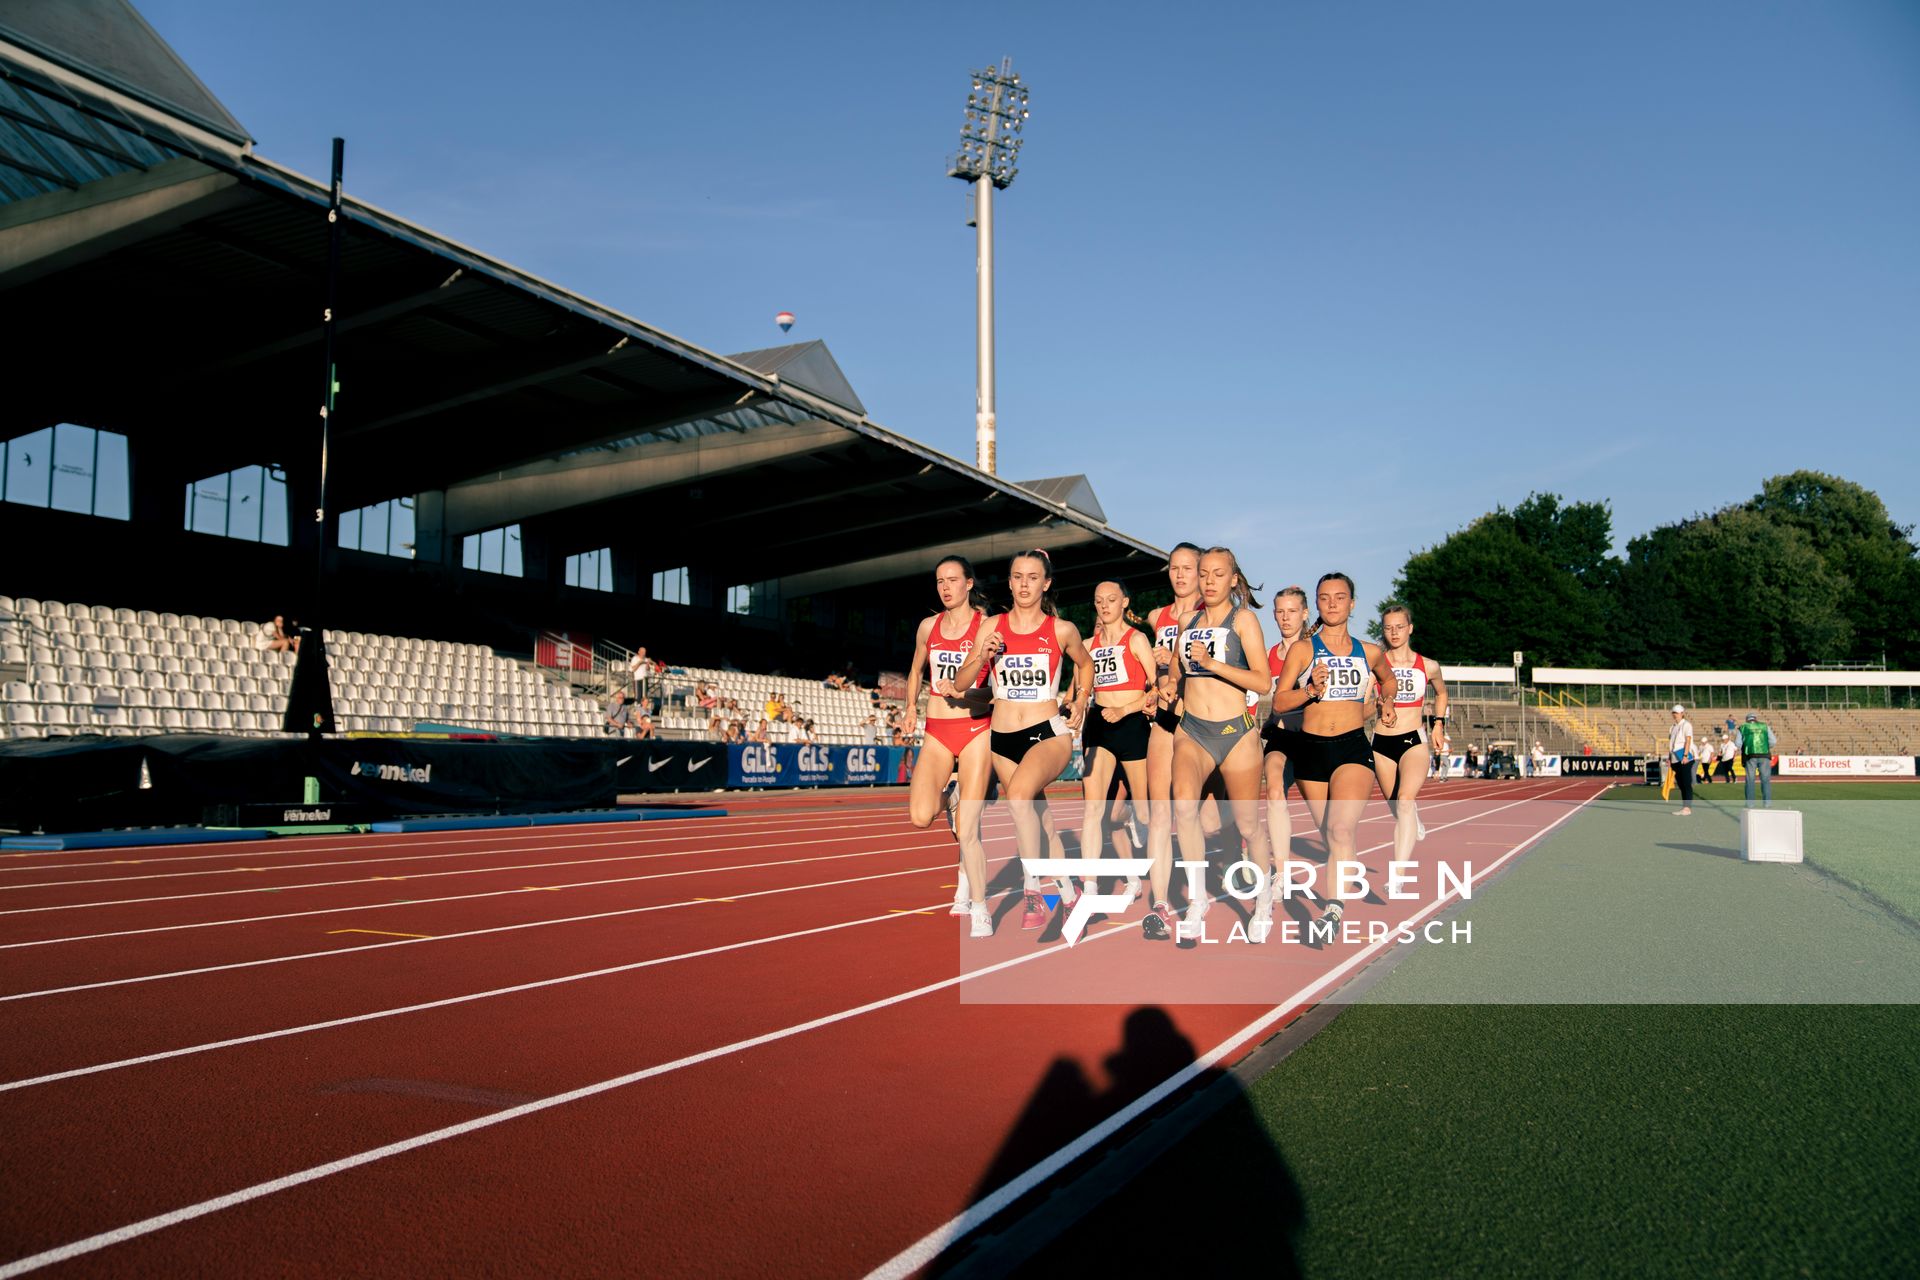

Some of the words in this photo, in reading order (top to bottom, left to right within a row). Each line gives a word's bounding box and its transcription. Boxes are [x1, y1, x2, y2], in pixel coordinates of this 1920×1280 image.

[328, 209, 337, 223] 6
[324, 308, 332, 322] 5
[315, 508, 324, 522] 3
[1165, 627, 1178, 637] GL
[1185, 641, 1215, 659] 54
[937, 664, 961, 681] 70
[1094, 657, 1117, 674] 575
[1000, 669, 1046, 687] 1099
[1329, 669, 1361, 686] 150
[1572, 760, 1629, 771] NOVAFON
[1788, 758, 1816, 769] Black
[1819, 758, 1851, 769] Forest
